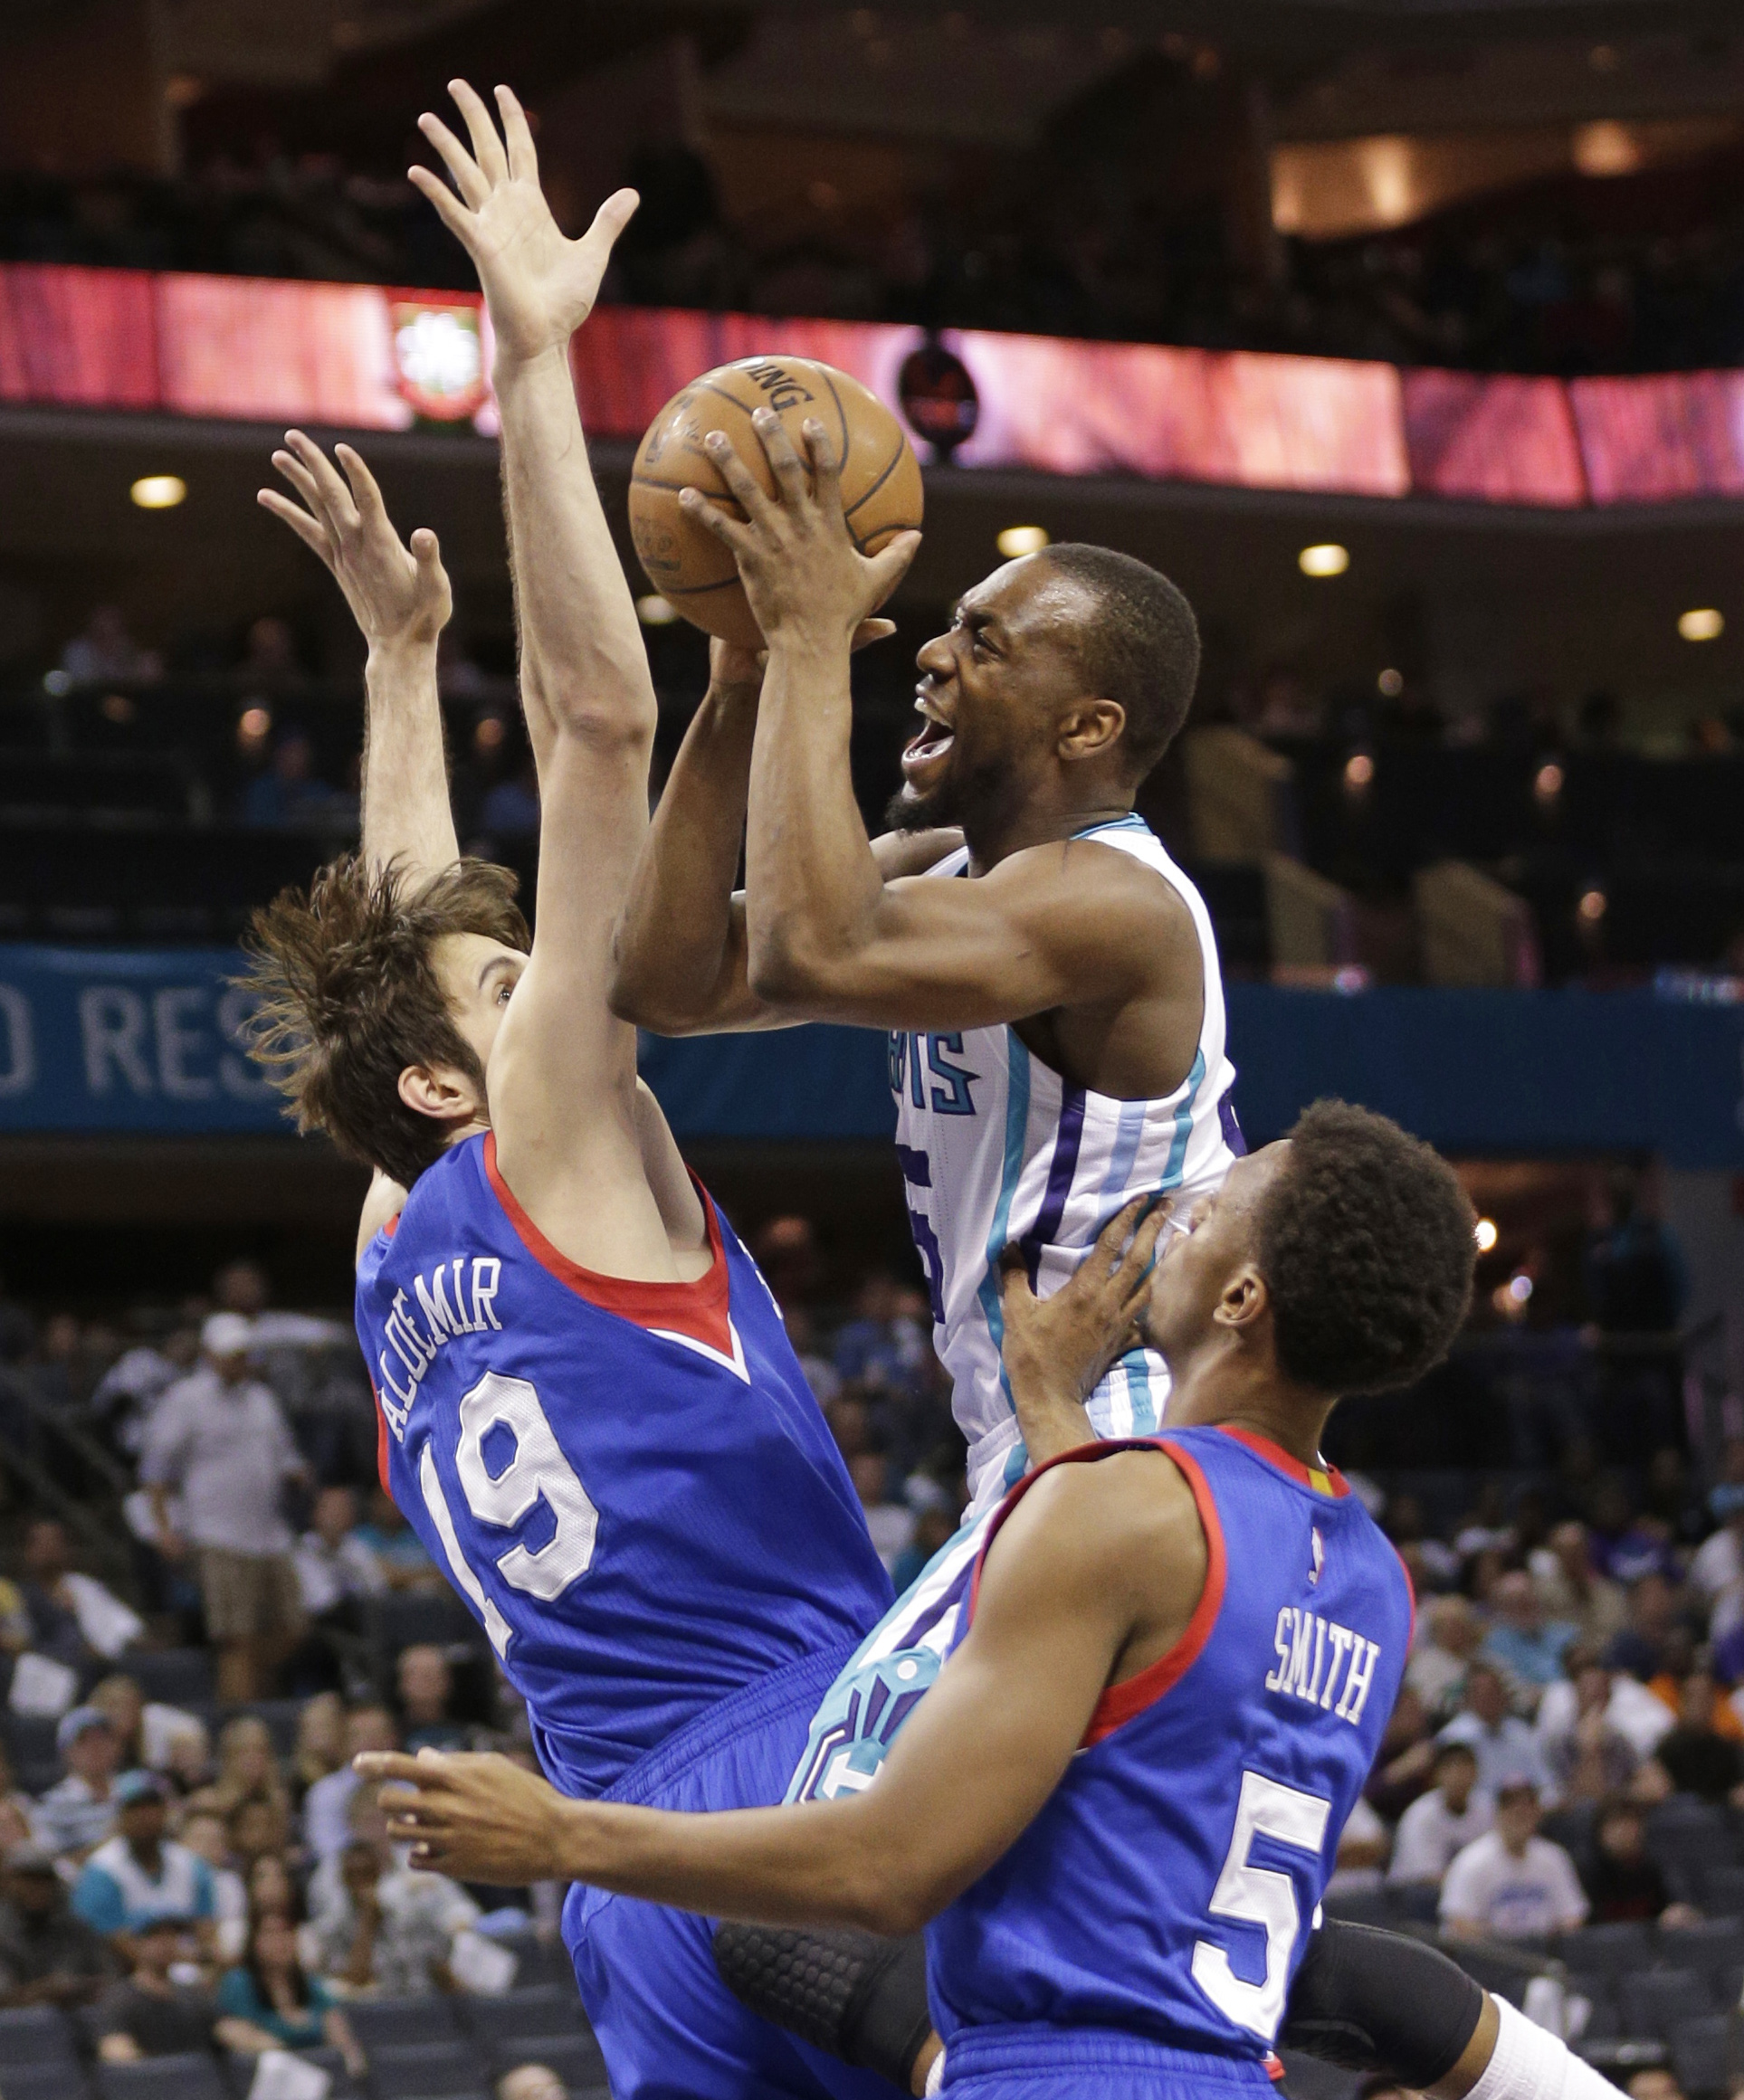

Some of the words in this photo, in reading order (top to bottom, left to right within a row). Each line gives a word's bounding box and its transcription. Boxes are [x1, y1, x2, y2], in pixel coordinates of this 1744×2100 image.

[80, 985, 291, 1100] RES
[379, 1257, 503, 1444] ALDEMIR
[420, 1369, 599, 1662] 19
[1265, 1606, 1381, 1726] SMITH
[1191, 1771, 1331, 2045] 5
